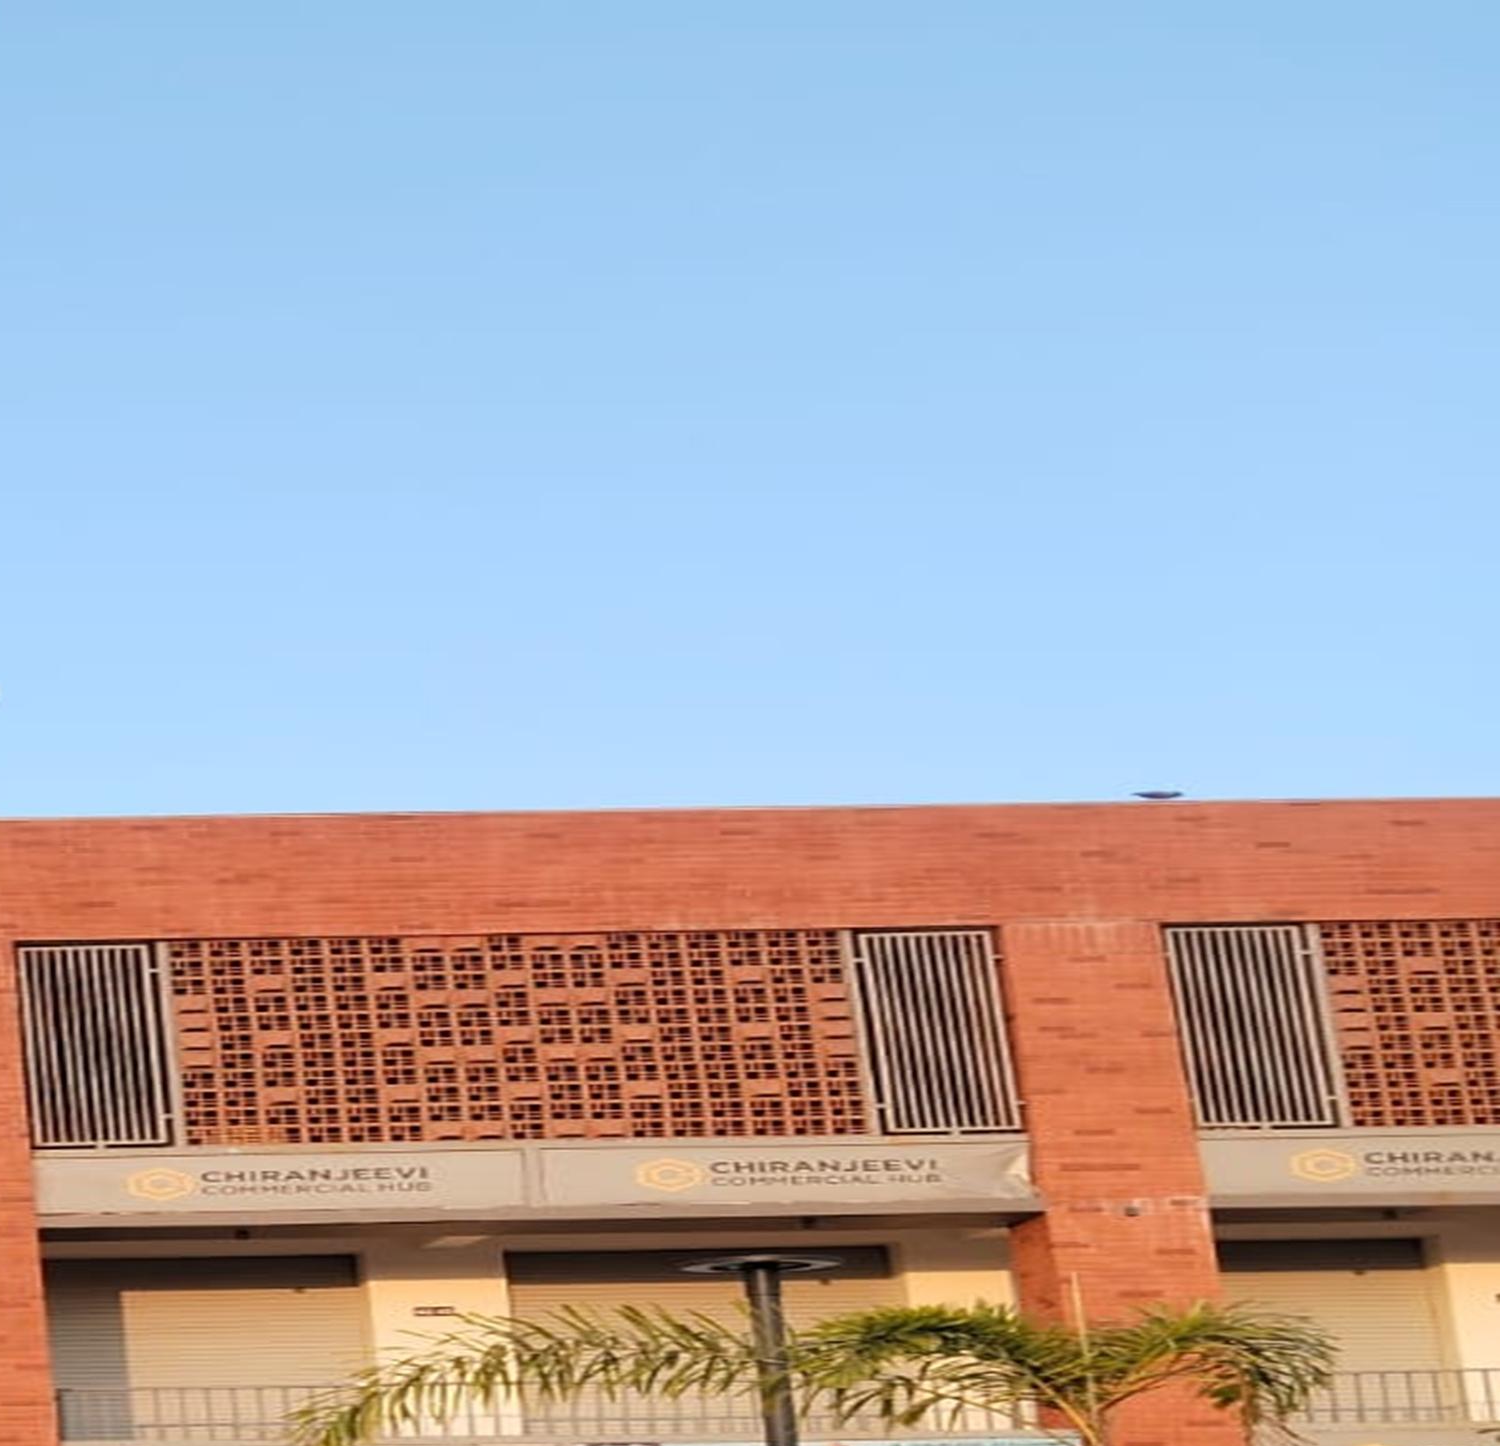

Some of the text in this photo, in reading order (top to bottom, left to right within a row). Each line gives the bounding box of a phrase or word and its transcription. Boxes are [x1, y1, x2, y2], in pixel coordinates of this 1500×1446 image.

[710, 1159, 937, 1174] CHIRANJEEVI
[200, 1167, 429, 1182] CHIRANJEEVI
[888, 1173, 943, 1184] HUB
[376, 1182, 432, 1193] HUB
